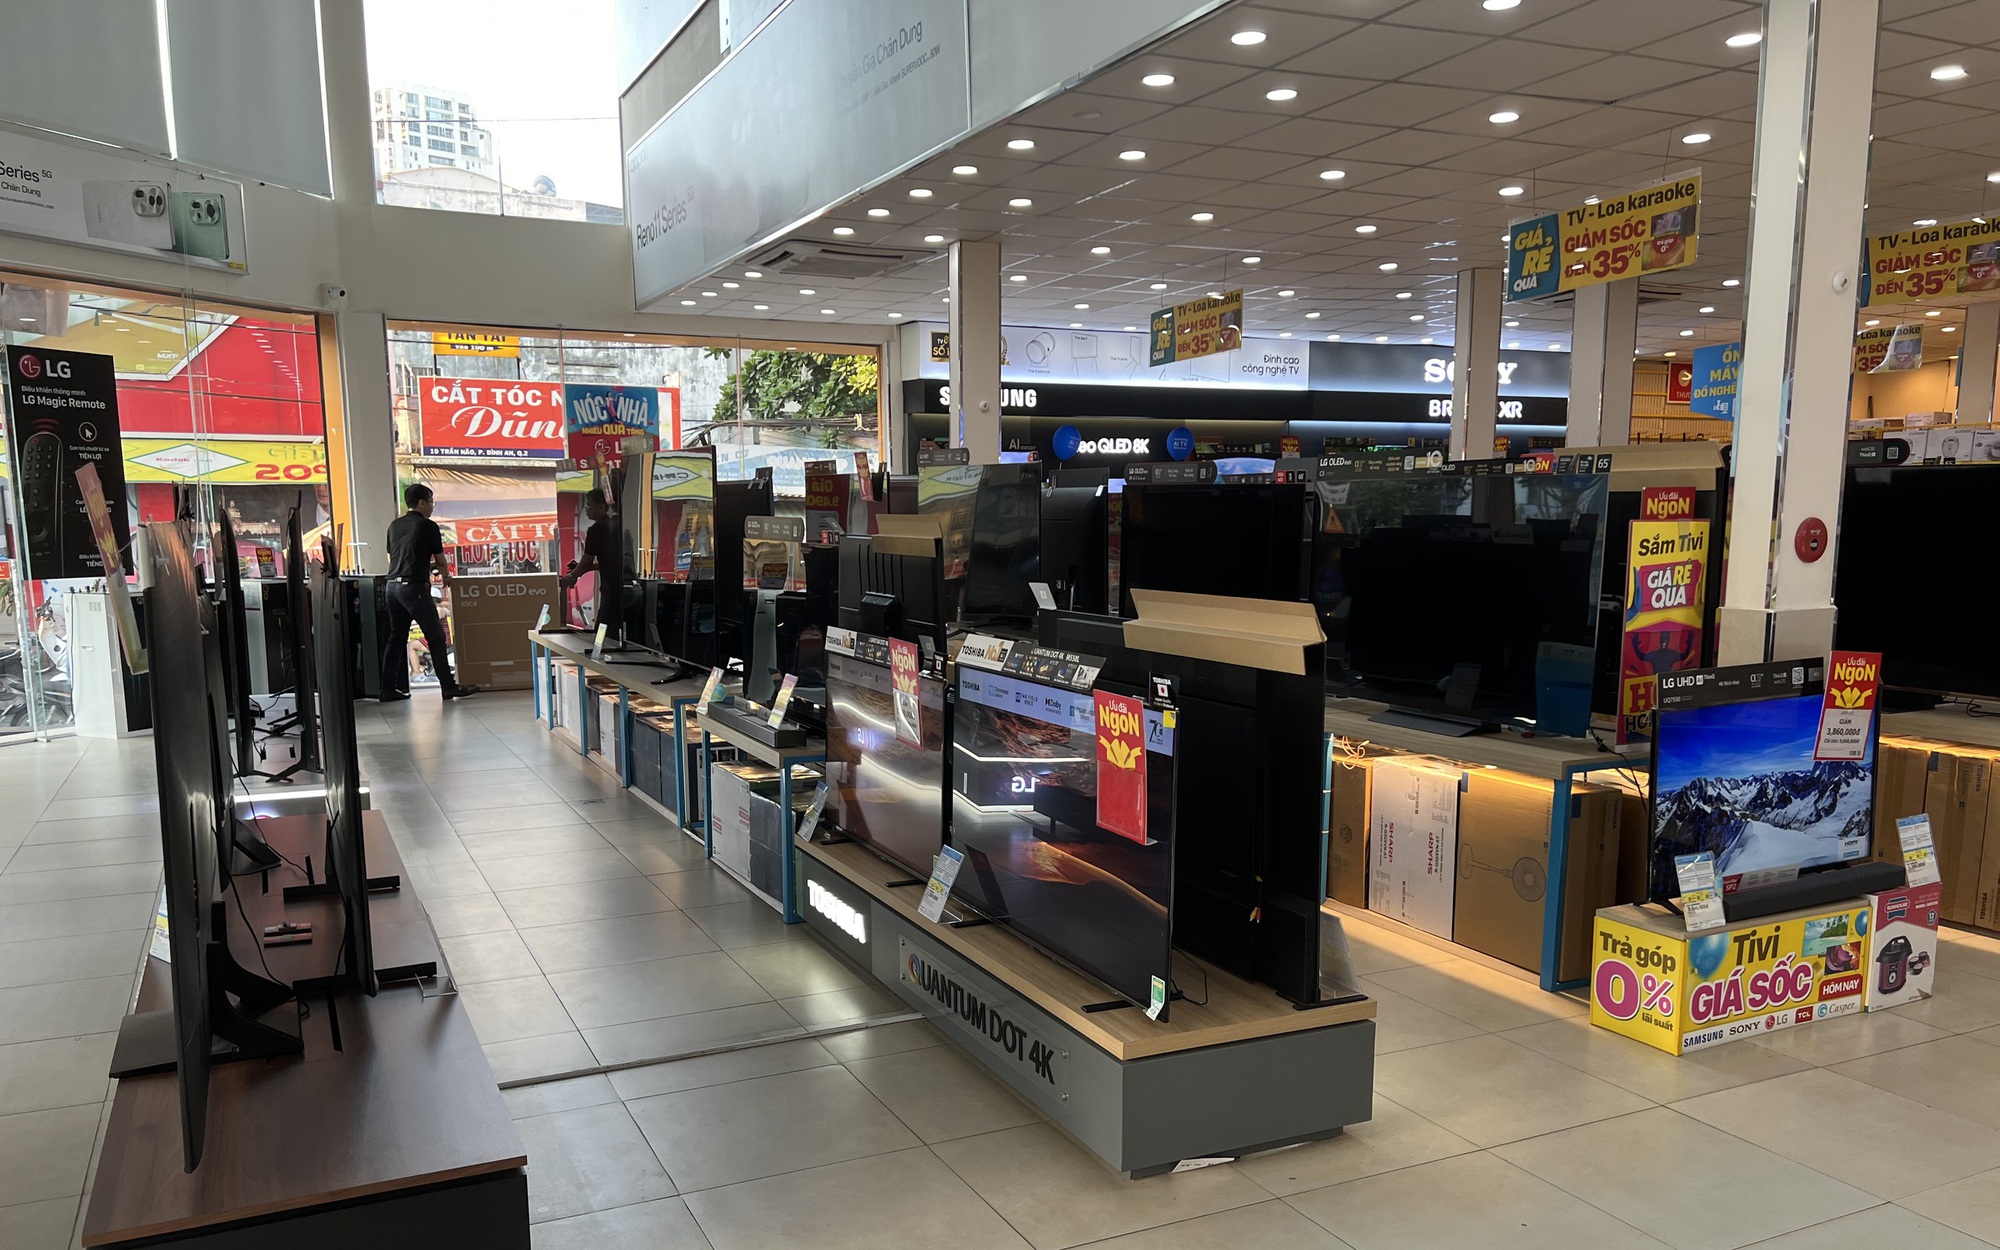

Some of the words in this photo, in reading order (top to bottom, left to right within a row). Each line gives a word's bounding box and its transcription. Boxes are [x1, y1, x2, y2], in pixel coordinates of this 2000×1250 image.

[899, 20, 924, 50] Dung
[41, 169, 53, 179] 5G
[21, 185, 42, 198] Dung
[661, 196, 687, 234] Series
[1567, 209, 1586, 227] TV
[1597, 201, 1625, 219] Loa
[1628, 182, 1695, 212] karaoke
[1514, 223, 1544, 251] GIÁ
[1564, 230, 1607, 254] GIẢM
[1609, 216, 1646, 242] SỐC
[1879, 234, 1900, 250] TV
[1911, 230, 1940, 245] Loa
[1521, 236, 1555, 277] RẺ
[1564, 258, 1591, 278] ĐẾN
[1593, 242, 1641, 279] 35%
[1875, 252, 1921, 274] GIẢM
[1923, 244, 1962, 268] SỐC
[1513, 275, 1538, 292] QUÁ
[1875, 278, 1904, 296] ĐẾN
[1905, 267, 1956, 298] 35%
[1178, 306, 1188, 318] TV
[1193, 301, 1207, 314] Loa
[1207, 292, 1241, 313] karaoke
[1177, 320, 1199, 336] GIẢM
[1198, 313, 1218, 329] SỐC
[1861, 331, 1878, 340] Loa
[1880, 325, 1921, 338] karaoke
[933, 343, 946, 356] SỐ
[1177, 341, 1191, 354] ĐẾN
[1191, 331, 1215, 355] 35%
[45, 359, 71, 379] LG
[1242, 364, 1264, 376] công
[1265, 366, 1287, 377] nghệ
[1288, 366, 1300, 375] TV
[1283, 357, 1300, 365] cao
[22, 394, 35, 405] LG
[37, 396, 67, 408] Magic
[69, 398, 106, 410] Remote
[53, 388, 70, 396] thông
[431, 380, 482, 404] CẮT
[491, 385, 542, 406] TÓC
[939, 385, 1037, 408] SUNG
[573, 392, 607, 424] NÓC
[1498, 401, 1523, 418] XR
[79, 452, 93, 460] TIỆN
[440, 447, 459, 455] TRẦN
[460, 448, 477, 456] NÃO,
[486, 448, 504, 456] BÌNH
[1009, 439, 1020, 450] AI
[1077, 440, 1097, 453] eo
[1098, 438, 1132, 453] QLED
[1132, 438, 1150, 454] 8K
[1320, 458, 1328, 467] LG
[1328, 457, 1345, 466] OLED
[1659, 491, 1668, 500] Ưu
[1646, 497, 1690, 519] NgoN
[465, 519, 524, 542] CẮT
[1638, 534, 1675, 556] Sắm
[1679, 531, 1704, 552] Tivi
[1647, 566, 1673, 589] GIÁ
[1673, 558, 1693, 585] RẺ
[460, 585, 480, 598] LG
[485, 584, 527, 597] OLED
[528, 588, 547, 596] evo
[1651, 584, 1687, 609] QUÁ
[892, 649, 915, 672] NgoN
[962, 645, 985, 658] TOSHIBA
[1847, 657, 1856, 666] Ưu
[1662, 678, 1675, 689] LG
[1676, 676, 1695, 688] UHD
[1834, 662, 1876, 686] NgoN
[962, 681, 981, 692] TOSHIBA
[1109, 700, 1118, 711] Ưu
[1119, 702, 1127, 714] đãi
[1099, 704, 1140, 737] NgoN
[1826, 728, 1861, 736] 3,860,000đ
[1976, 764, 1984, 793] TOSHIBA
[1980, 892, 1988, 920] TOSHIBA
[1600, 930, 1632, 958] Trả
[1636, 946, 1676, 974] góp
[1734, 925, 1781, 965] Tivi
[1595, 959, 1674, 1020] 0%
[1690, 966, 1746, 1025] GIÁ
[1748, 952, 1813, 1010] SỐC
[1823, 979, 1842, 995] HÔM
[1843, 979, 1860, 991] NAY
[908, 953, 987, 1035] QUANTUM
[989, 1009, 1027, 1062] DOT
[1028, 1039, 1055, 1086] 4K
[1642, 1011, 1652, 1025] lãi
[1654, 1016, 1674, 1032] suất
[1684, 1029, 1723, 1048] SAMSUNG
[1729, 1021, 1762, 1036] SONY
[1777, 1013, 1788, 1026] LG
[1797, 1011, 1811, 1019] TCL
[1829, 1001, 1855, 1014] Casper
